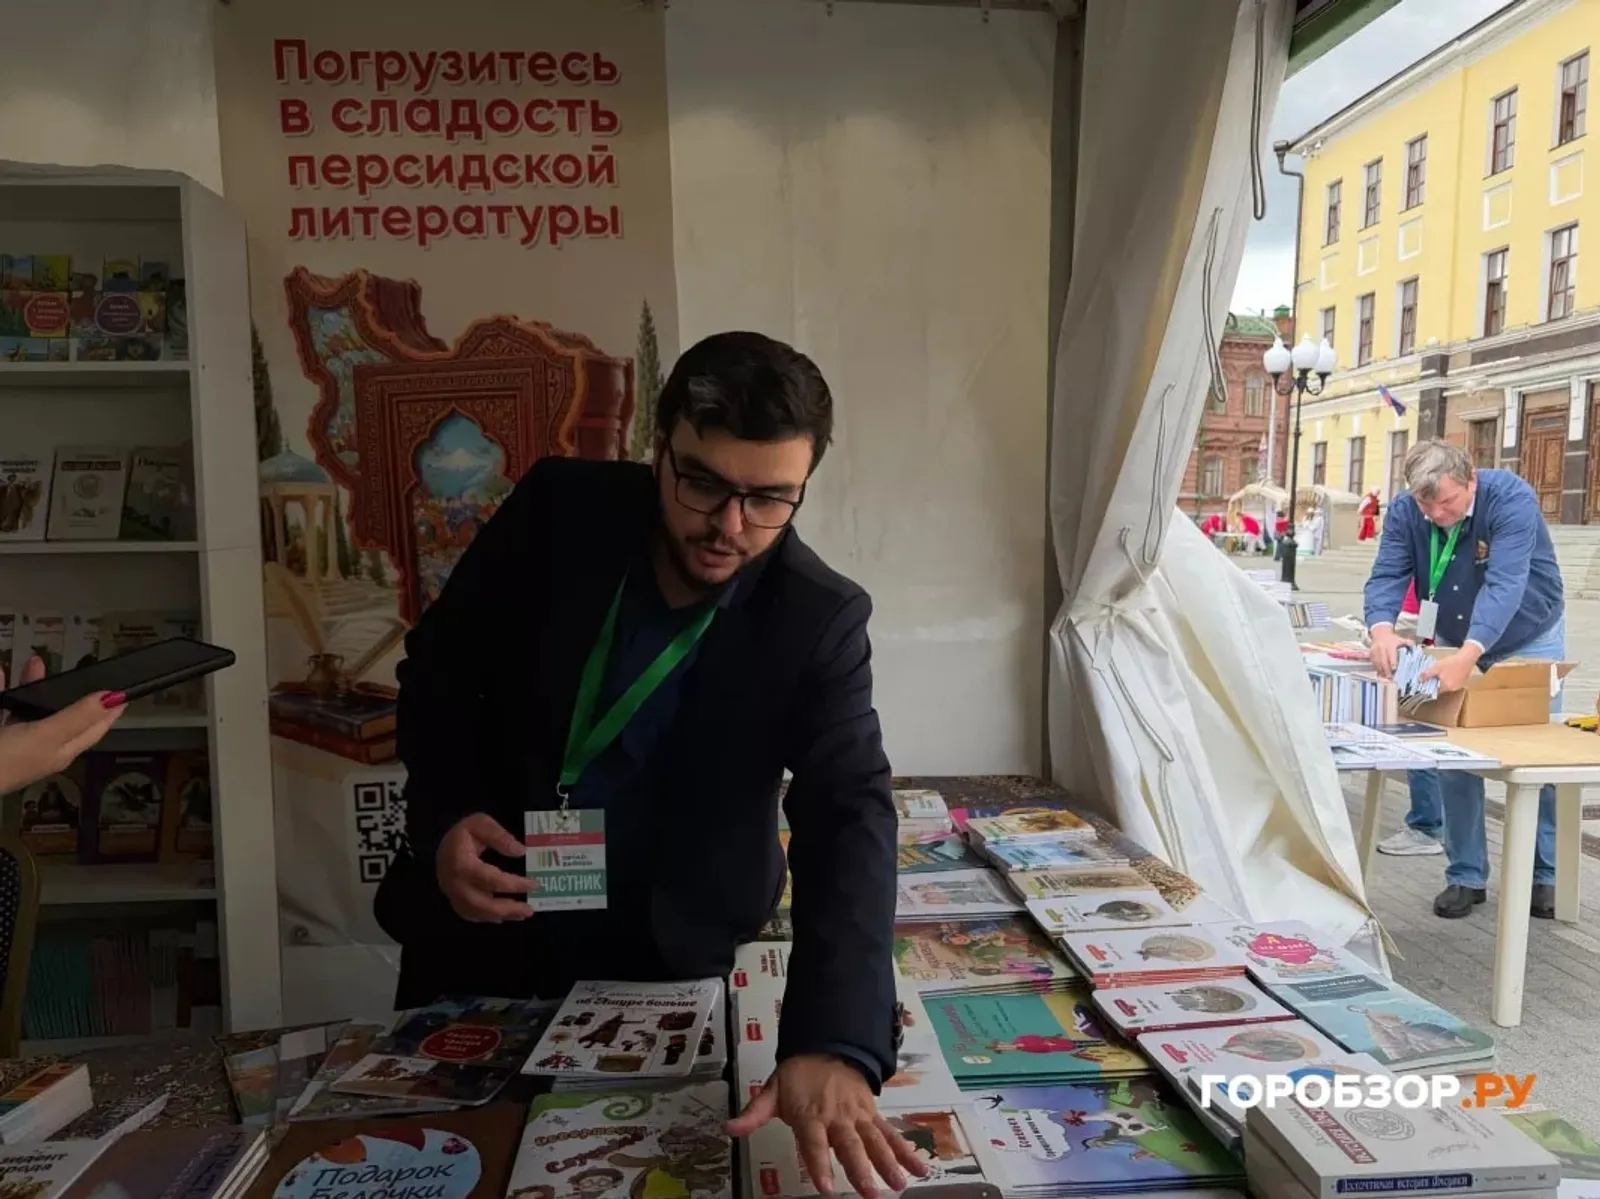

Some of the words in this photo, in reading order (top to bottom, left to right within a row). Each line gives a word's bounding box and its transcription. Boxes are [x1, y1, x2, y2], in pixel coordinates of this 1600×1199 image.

[274, 38, 621, 93] Погрузитесь
[280, 98, 311, 135] в
[331, 97, 621, 142] сладость
[288, 144, 618, 197] персидской
[288, 203, 622, 247] литературы
[312, 1161, 456, 1187] Подарок
